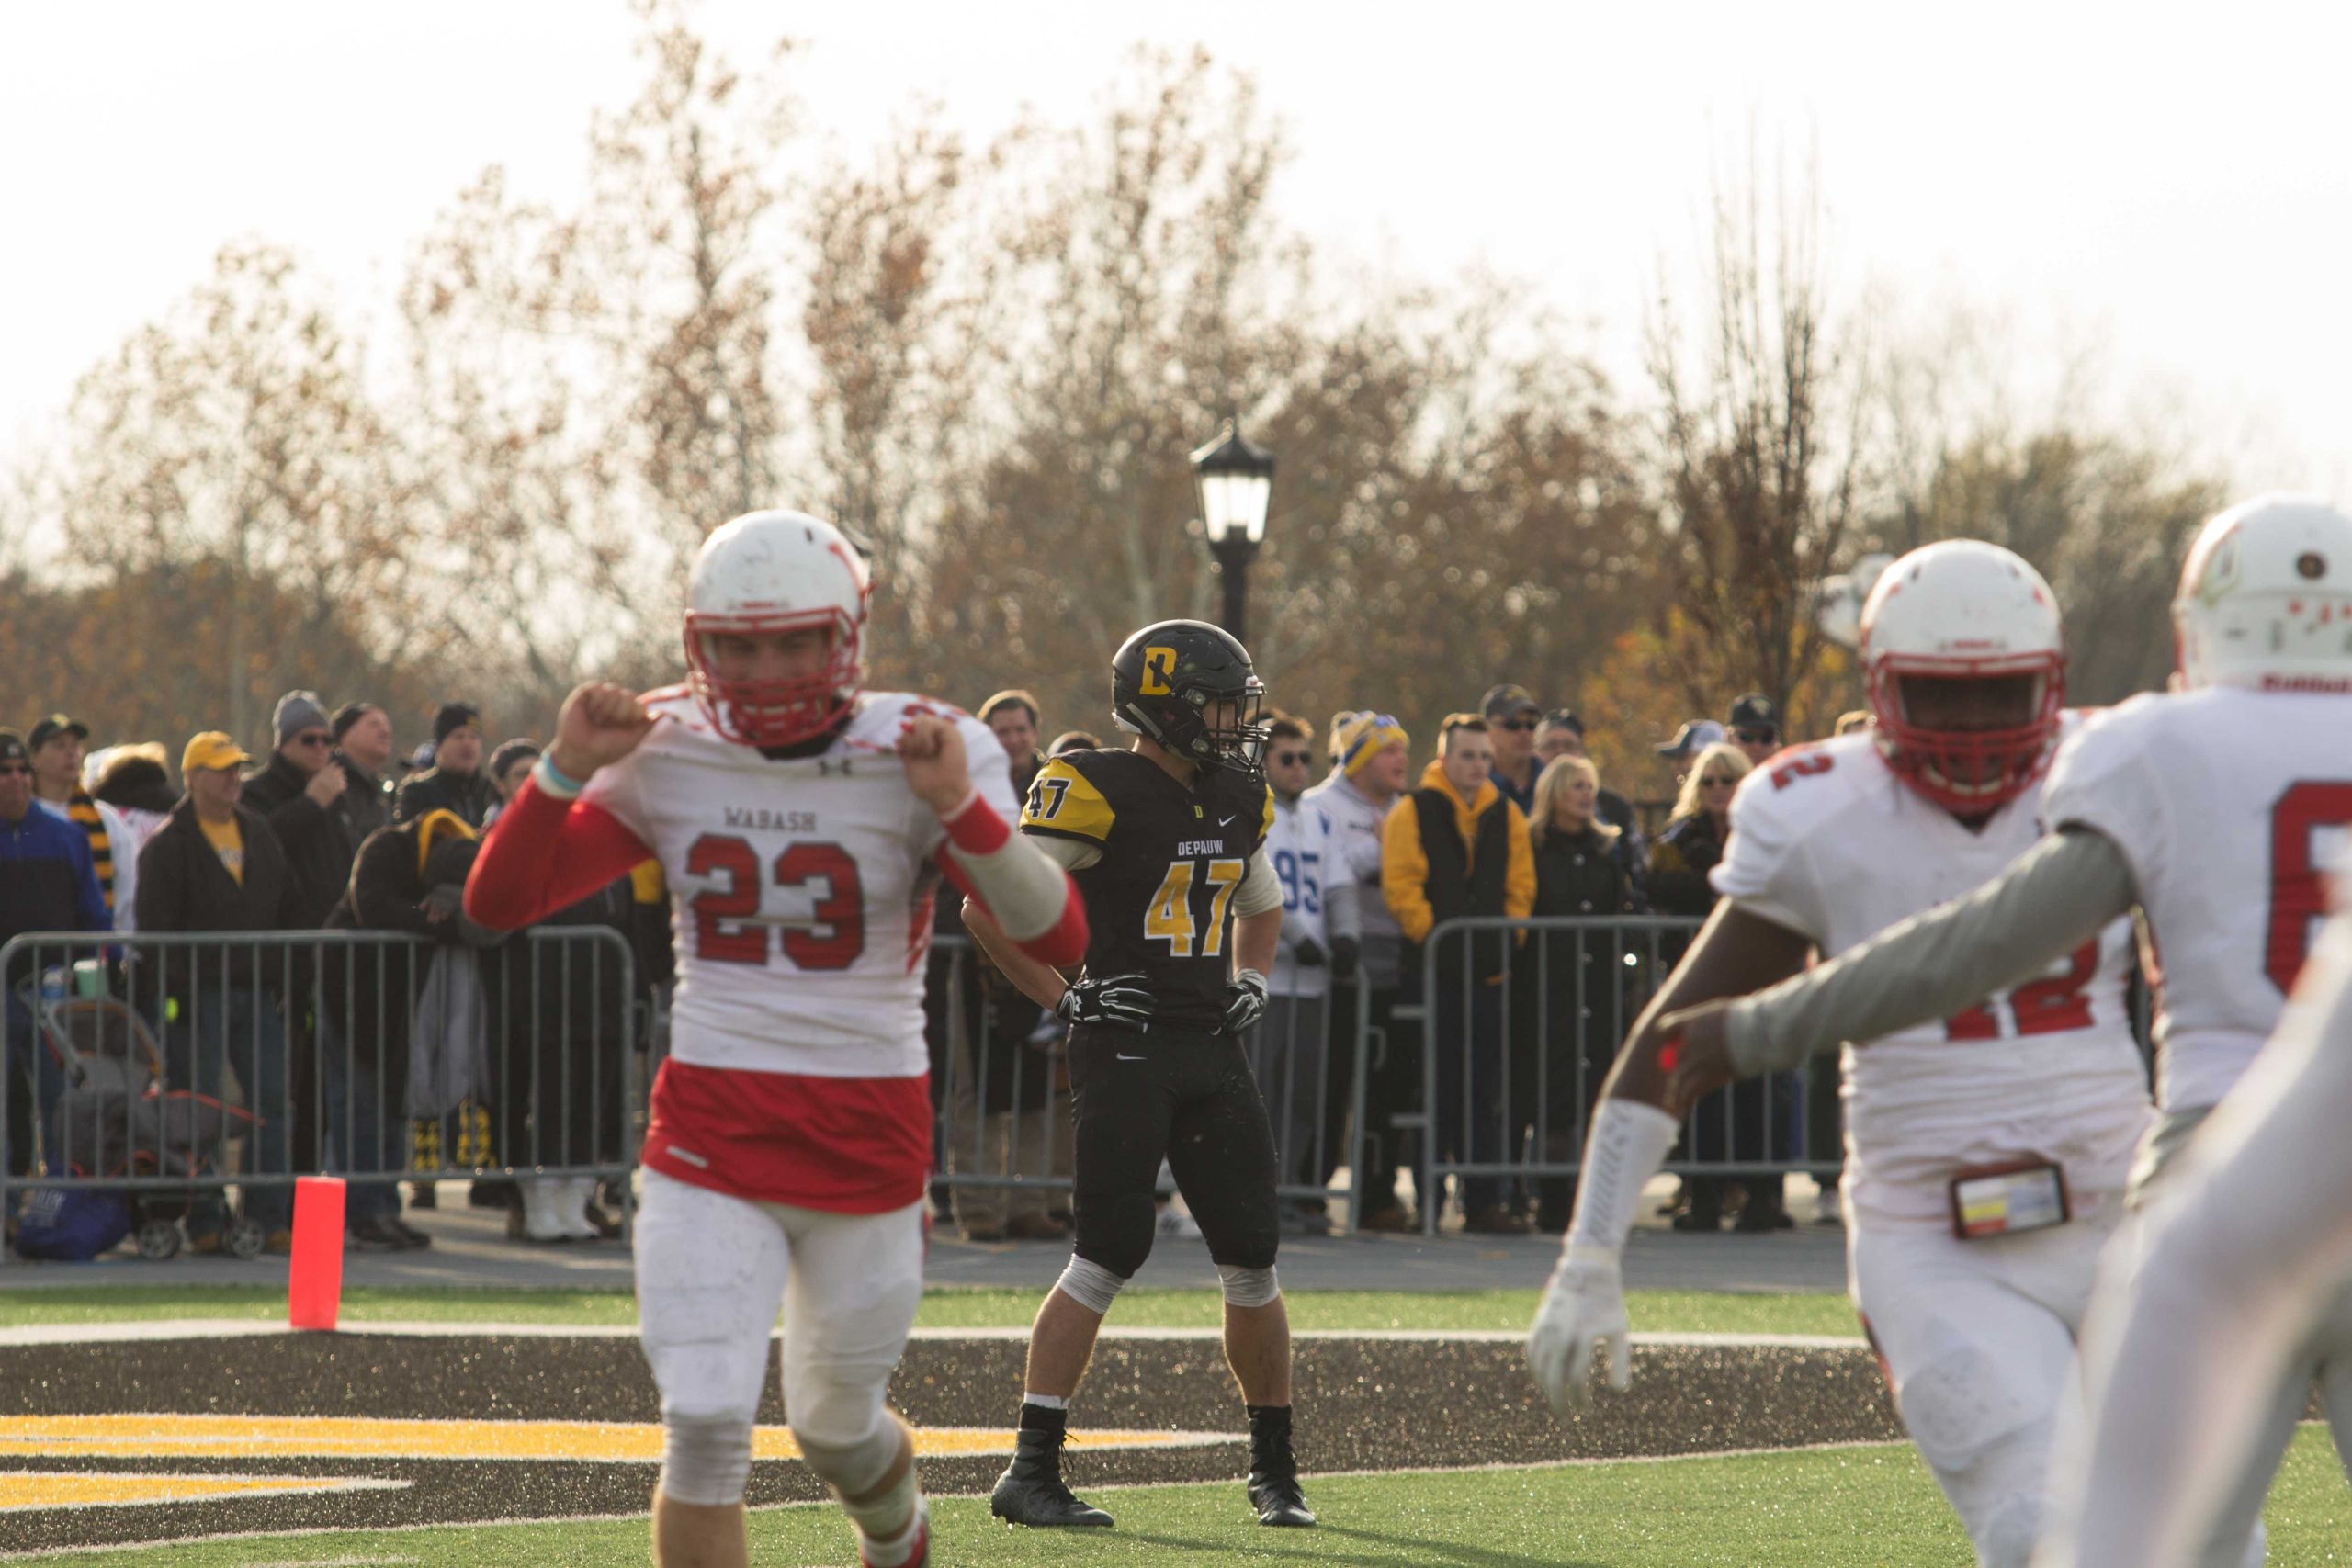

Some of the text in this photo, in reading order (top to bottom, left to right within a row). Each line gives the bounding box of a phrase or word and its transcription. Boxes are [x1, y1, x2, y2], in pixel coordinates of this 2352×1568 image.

[724, 807, 817, 832] WABASH
[1027, 777, 1073, 820] 47
[1178, 840, 1223, 856] DEPAUW
[686, 832, 865, 971] 23
[1144, 858, 1244, 957] 47
[1274, 849, 1319, 915] 95
[1944, 935, 2098, 1042] 2
